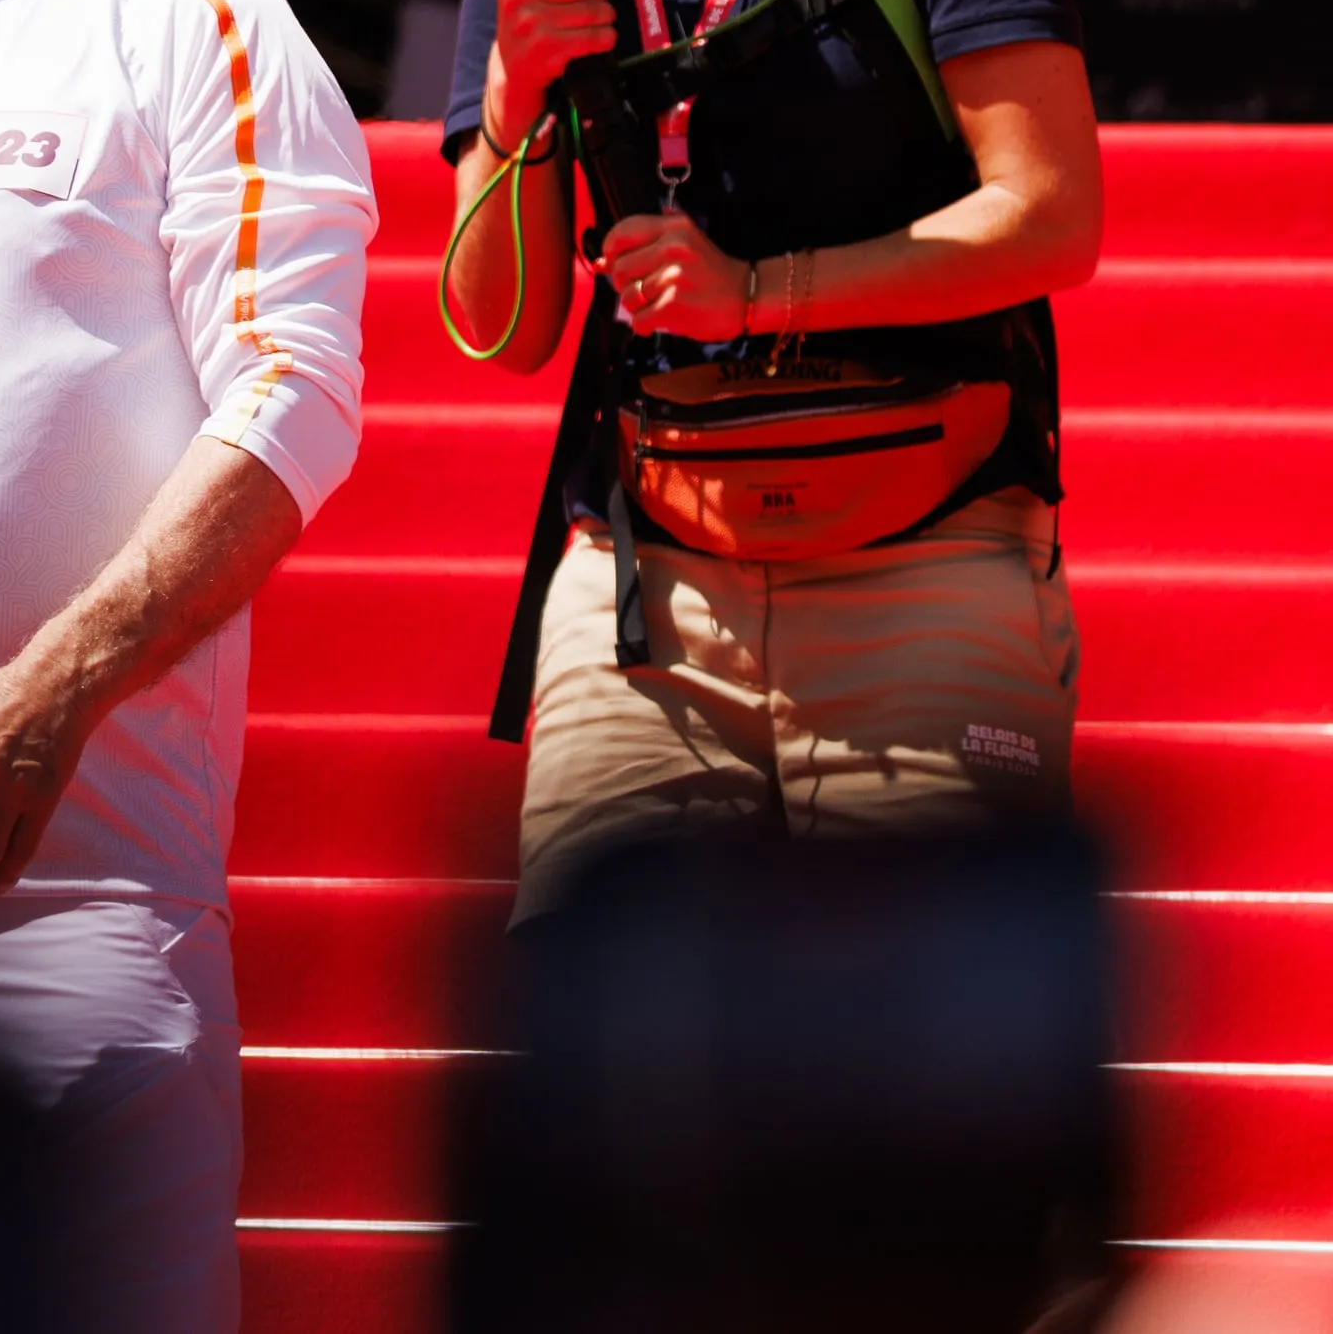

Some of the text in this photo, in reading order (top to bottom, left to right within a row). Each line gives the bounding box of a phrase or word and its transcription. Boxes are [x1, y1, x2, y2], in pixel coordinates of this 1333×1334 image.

[967, 724, 1037, 750] RELAIS DE
[961, 737, 1040, 766] LA FLAMME
